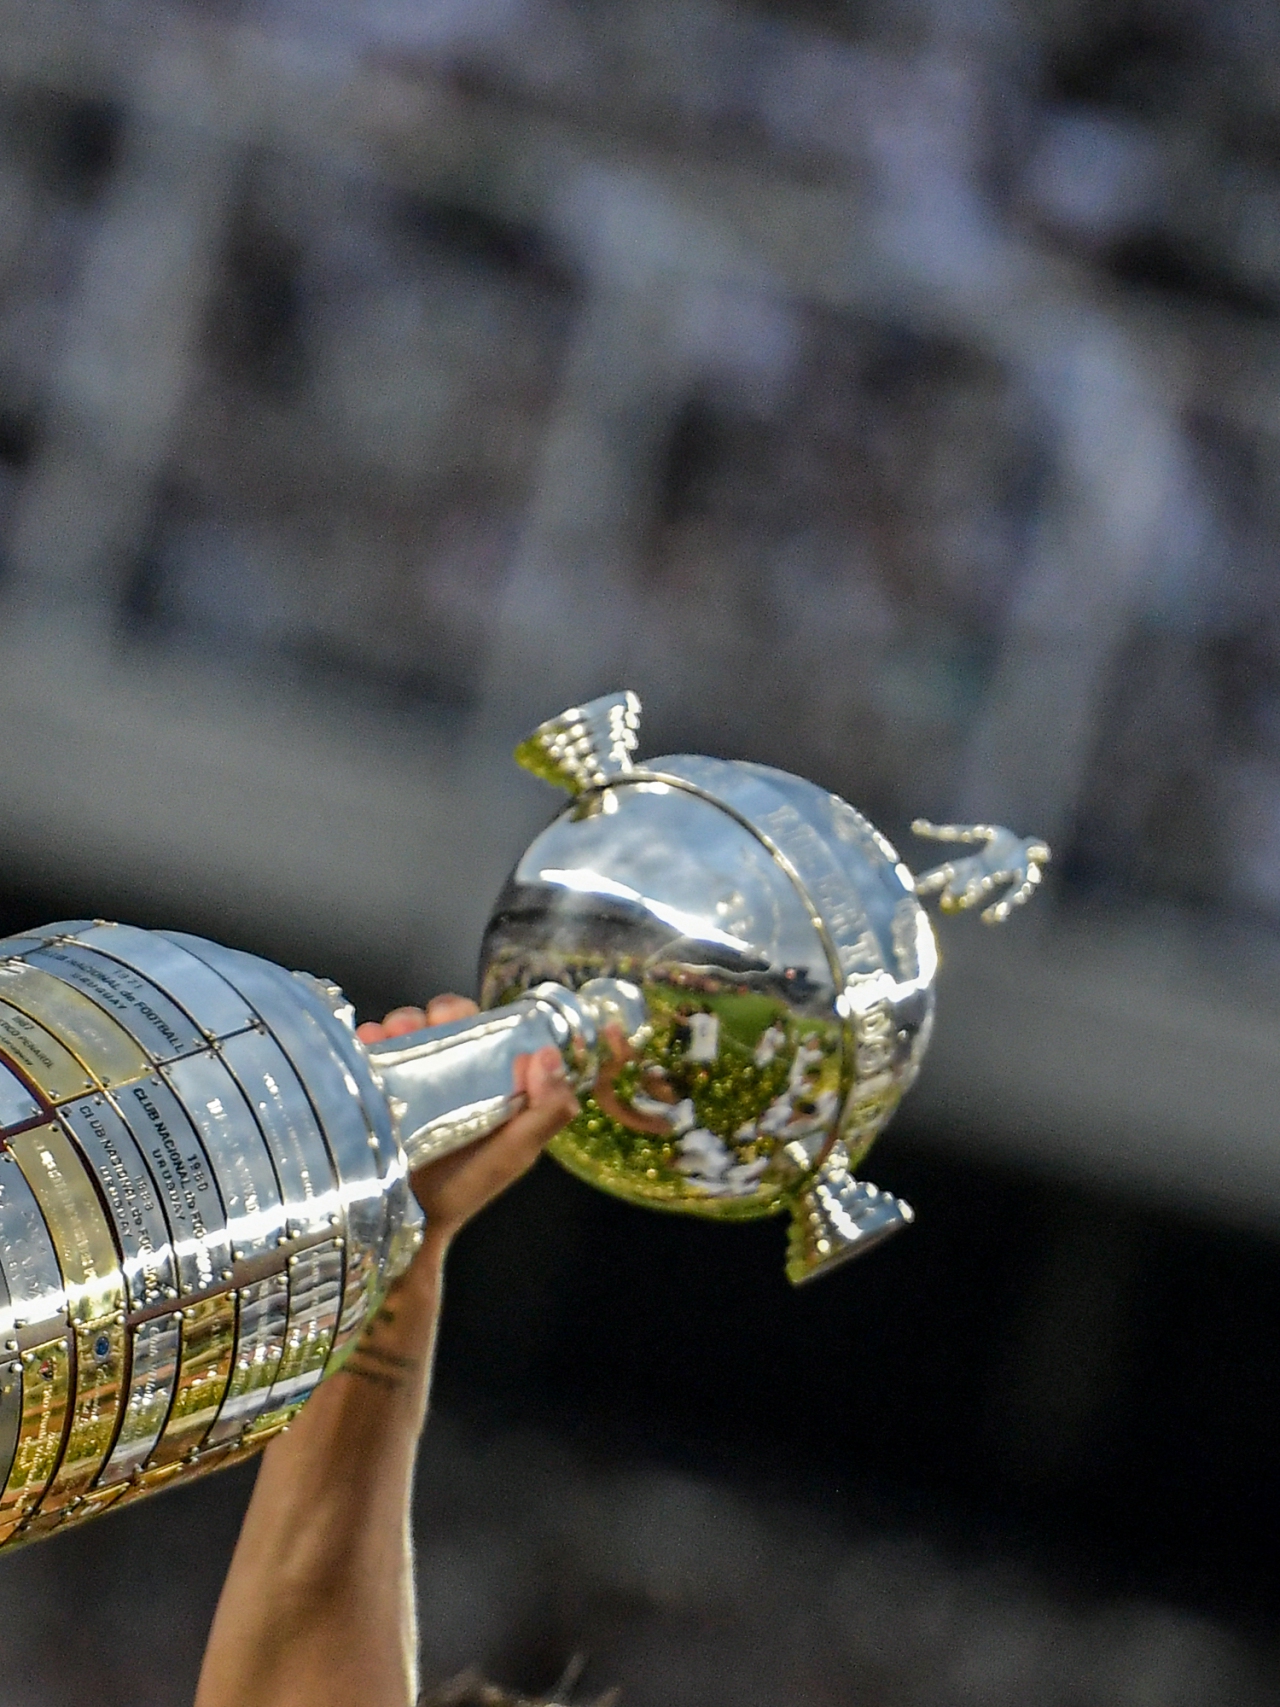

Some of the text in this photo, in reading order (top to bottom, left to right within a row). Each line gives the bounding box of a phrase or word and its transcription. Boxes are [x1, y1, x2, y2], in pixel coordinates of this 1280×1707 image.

[134, 1001, 184, 1054] FOOTBALL
[79, 1104, 108, 1139] CLUB
[133, 1087, 160, 1122] CLUB
[154, 1121, 193, 1190] NACIONAL
